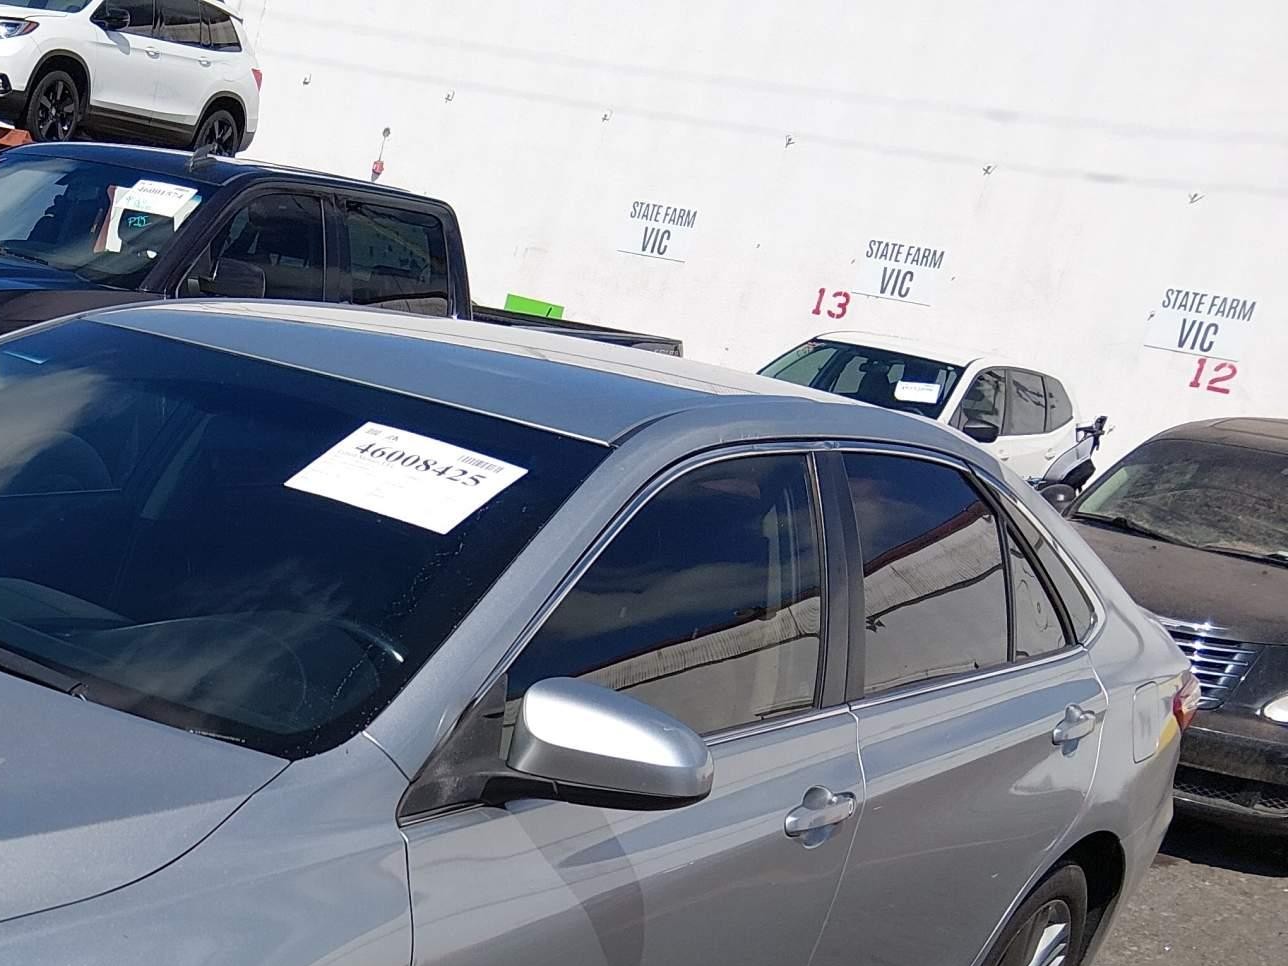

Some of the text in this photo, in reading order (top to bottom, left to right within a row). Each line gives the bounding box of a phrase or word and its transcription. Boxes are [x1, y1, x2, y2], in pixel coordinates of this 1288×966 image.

[630, 201, 698, 229] STATE FARM
[641, 226, 671, 256] VIC
[865, 239, 945, 270] STATE FARM
[879, 266, 914, 298] VIC
[811, 287, 851, 319] 13
[1161, 288, 1257, 322] STATE FARM
[1177, 318, 1219, 352] VIC
[1189, 358, 1237, 394] 12
[355, 442, 487, 487] 46008425
